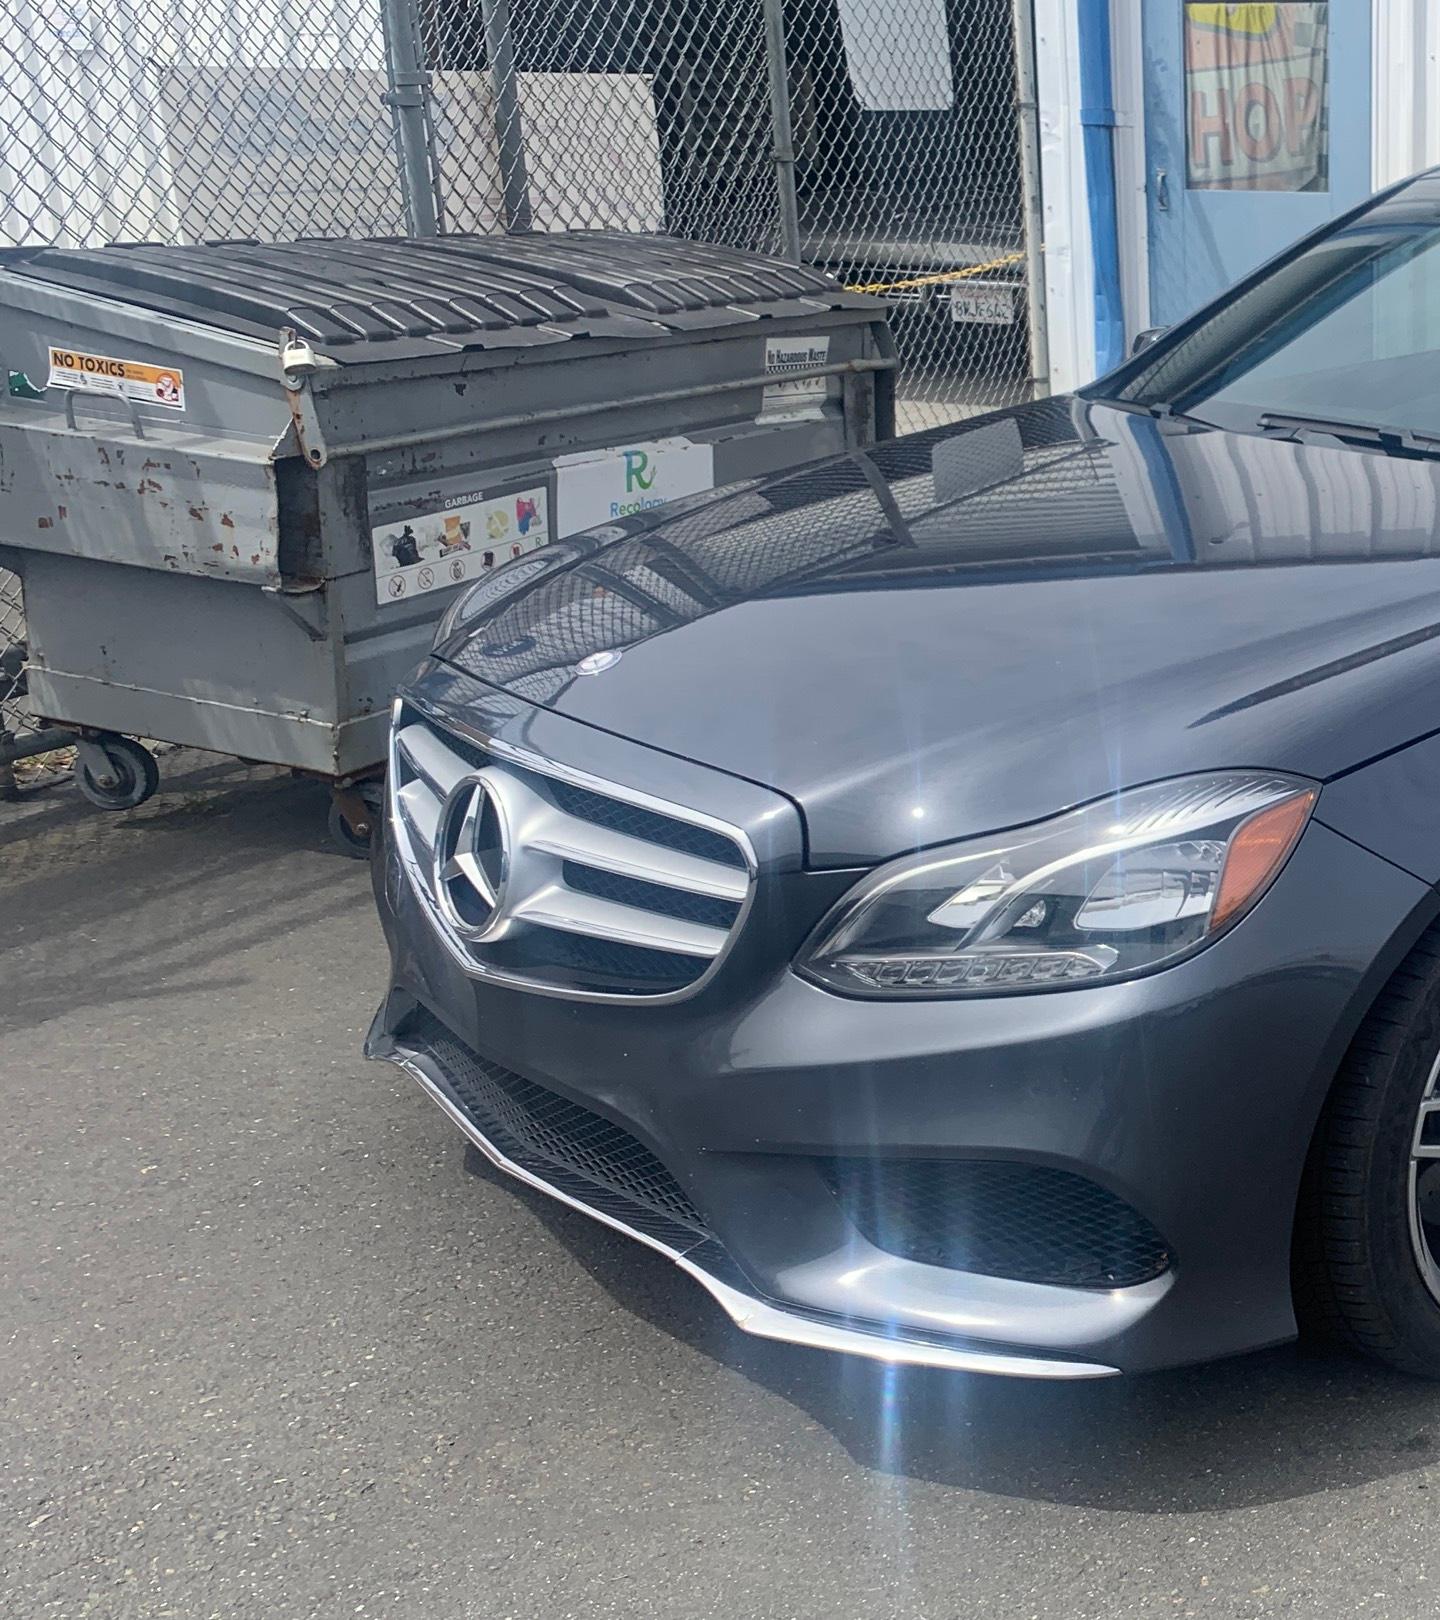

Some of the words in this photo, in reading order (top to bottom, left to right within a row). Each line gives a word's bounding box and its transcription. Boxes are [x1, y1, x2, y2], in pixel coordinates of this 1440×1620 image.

[53, 352, 75, 368] NO
[78, 356, 126, 378] TOXICS
[623, 449, 657, 493] R
[444, 491, 484, 509] GARBAGE
